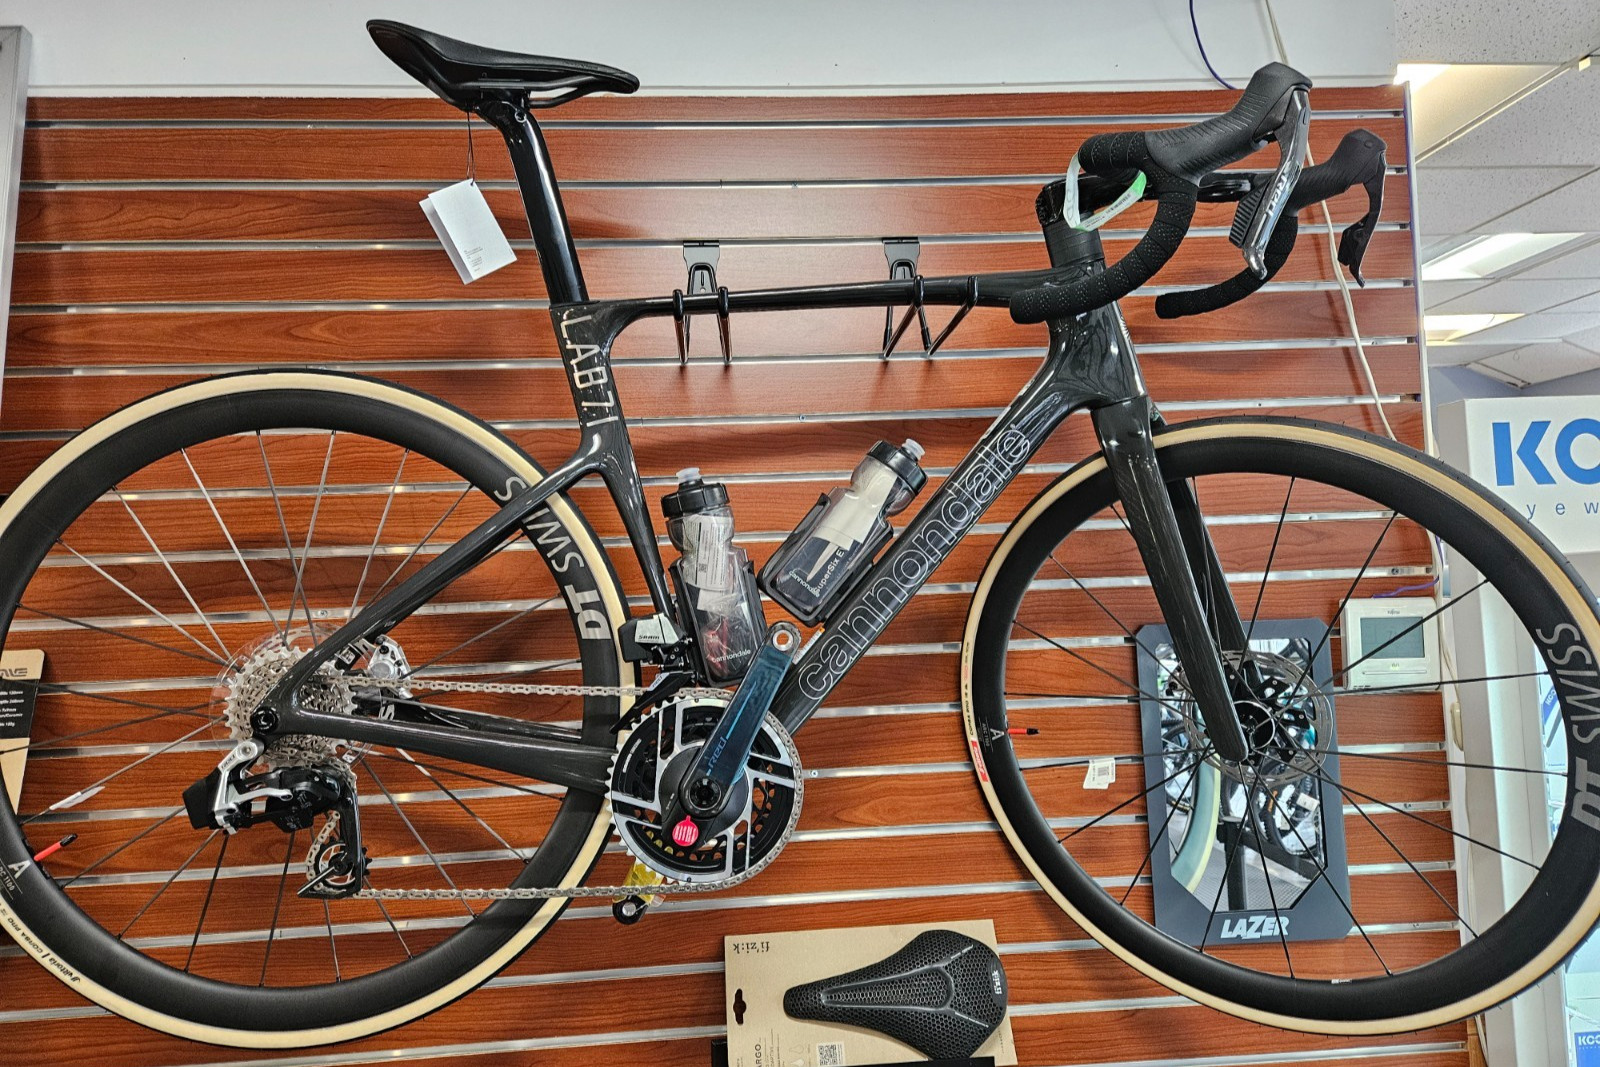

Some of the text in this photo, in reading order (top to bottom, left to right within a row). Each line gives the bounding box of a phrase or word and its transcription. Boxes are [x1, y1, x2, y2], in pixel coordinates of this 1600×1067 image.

[560, 314, 619, 428] LAB71
[493, 475, 612, 640] DT SWIS
[798, 429, 1031, 700] cannondale
[711, 648, 751, 663] cannondale
[1220, 915, 1290, 940] LAZER
